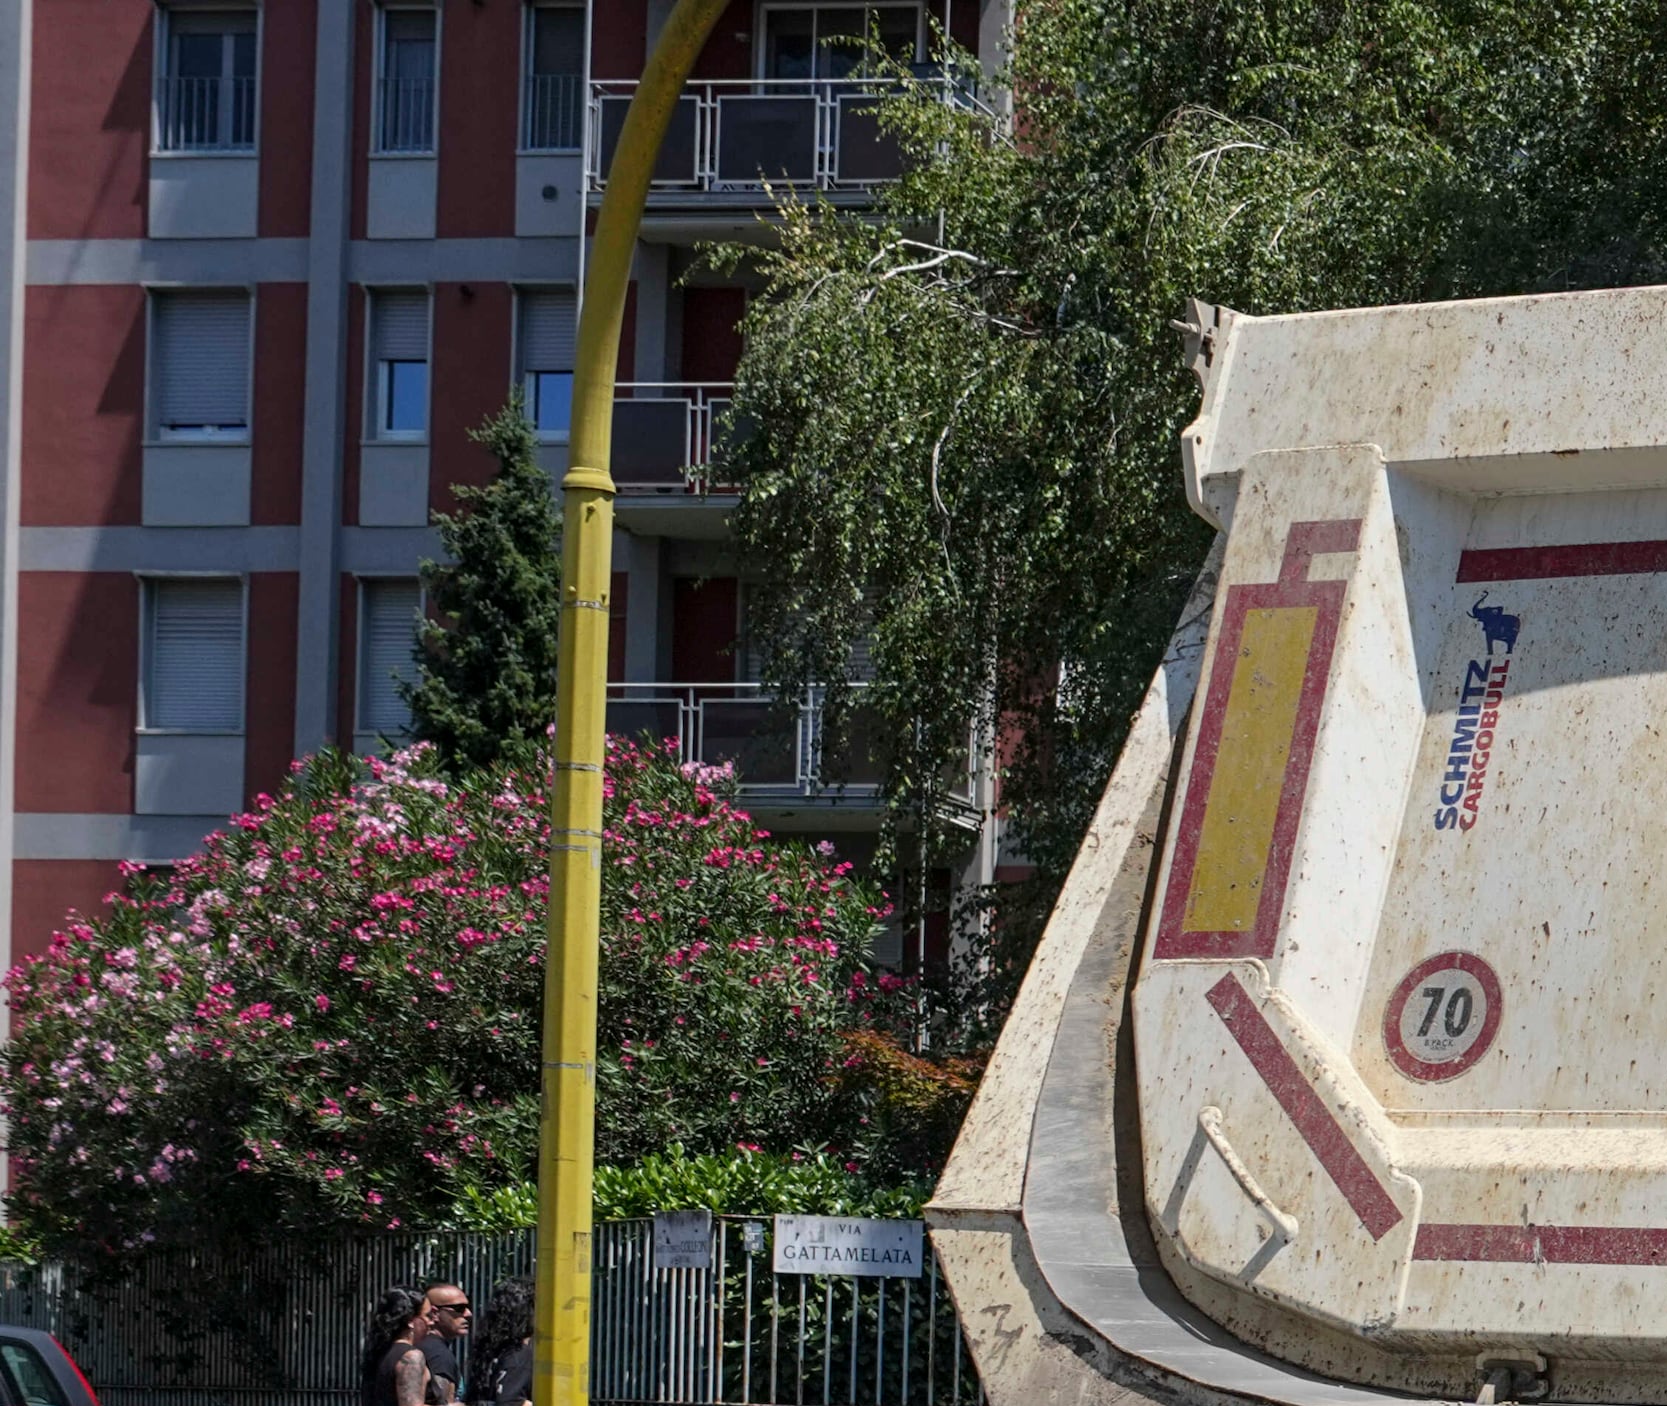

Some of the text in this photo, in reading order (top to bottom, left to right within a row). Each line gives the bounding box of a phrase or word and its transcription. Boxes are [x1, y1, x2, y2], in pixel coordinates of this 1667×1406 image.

[1434, 658, 1492, 831] SCHMITZ
[1458, 659, 1511, 833] CARGOBULL
[1416, 986, 1474, 1038] 70
[783, 1244, 913, 1265] GATTAMELATA
[838, 1223, 862, 1235] VIA
